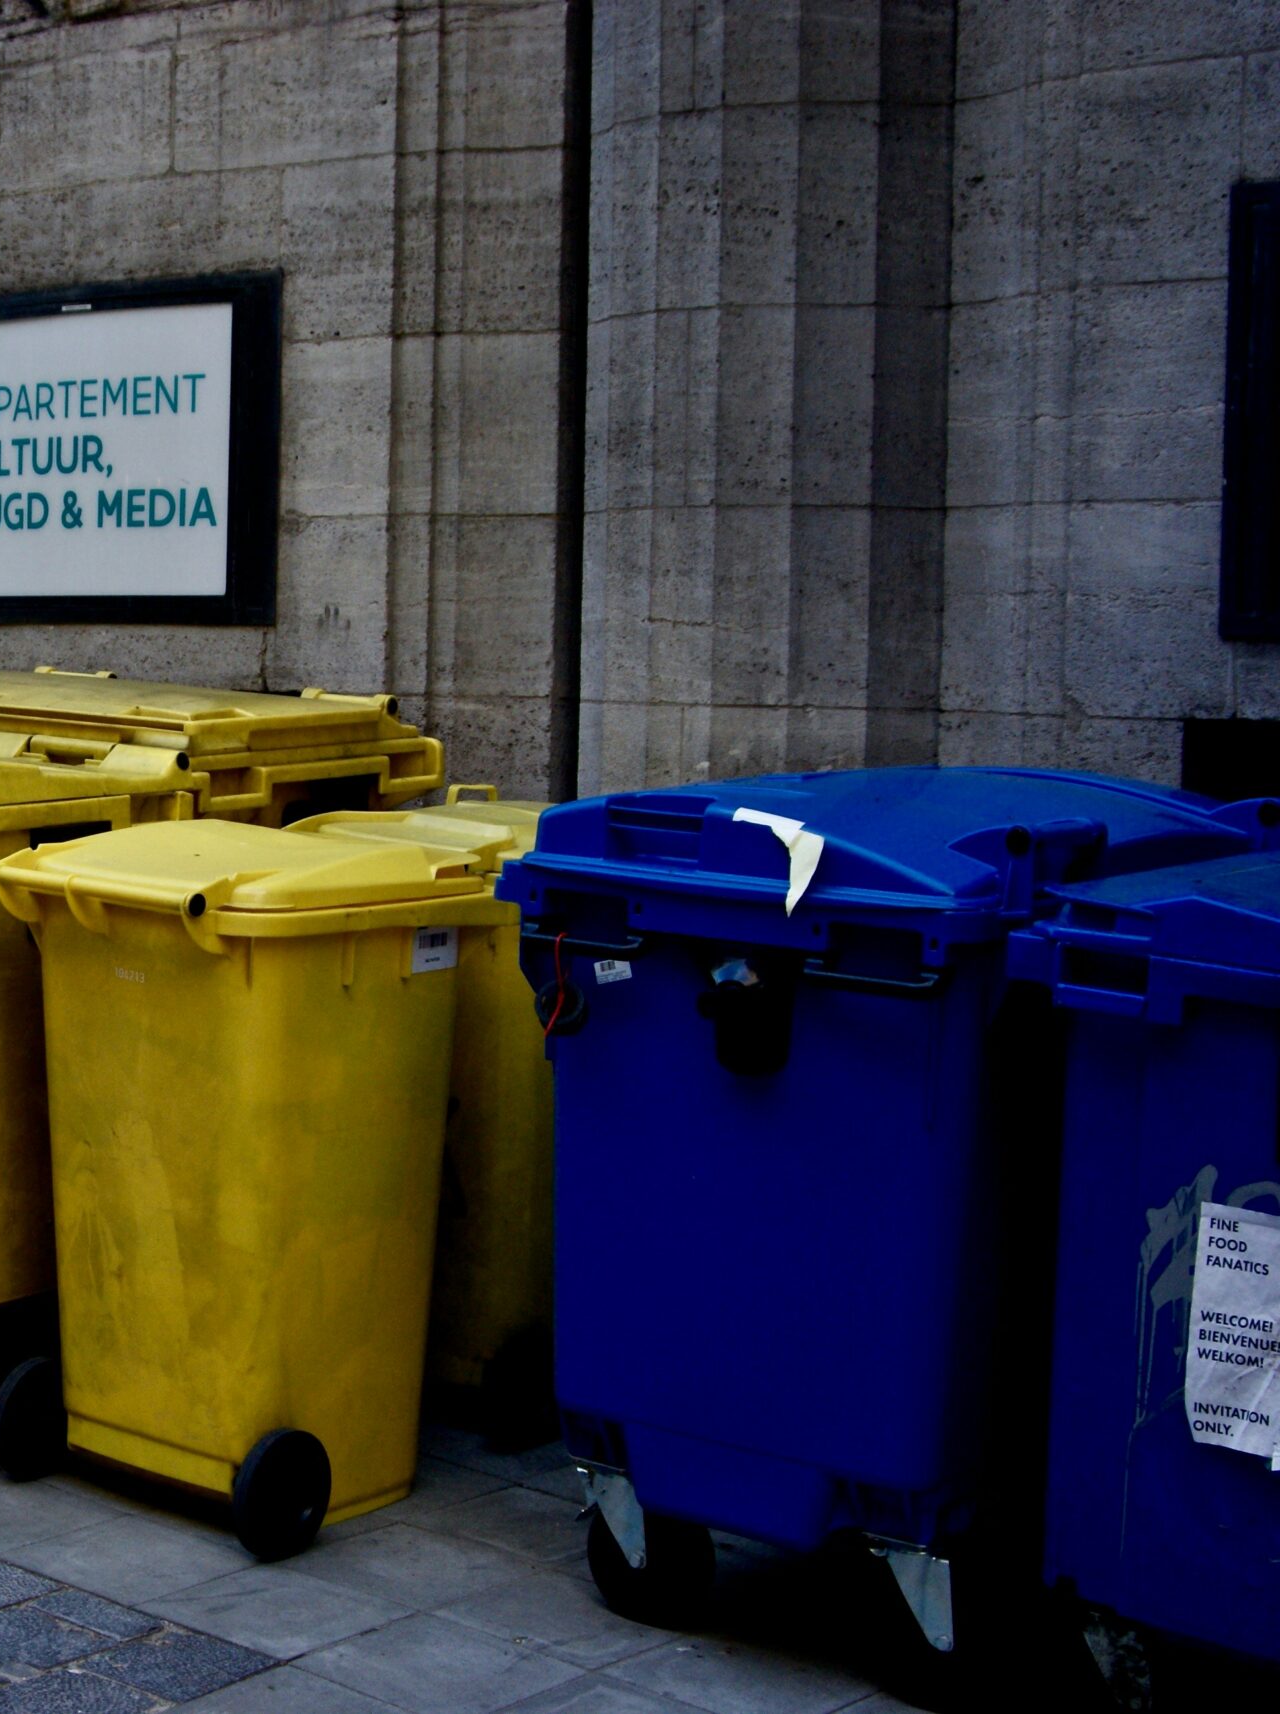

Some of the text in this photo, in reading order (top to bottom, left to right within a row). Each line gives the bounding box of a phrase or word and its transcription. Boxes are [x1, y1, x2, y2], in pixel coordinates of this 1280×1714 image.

[60, 490, 83, 529] &
[97, 487, 217, 528] MEDIA
[1209, 1217, 1239, 1233] FINE
[1208, 1236, 1248, 1253] FOOD
[1206, 1254, 1269, 1276] FANATICS
[1200, 1309, 1273, 1333] WELCOME!
[1197, 1346, 1265, 1368] WELKOM!
[1193, 1401, 1270, 1427] INVITATION
[1192, 1419, 1234, 1437] ONLY.
